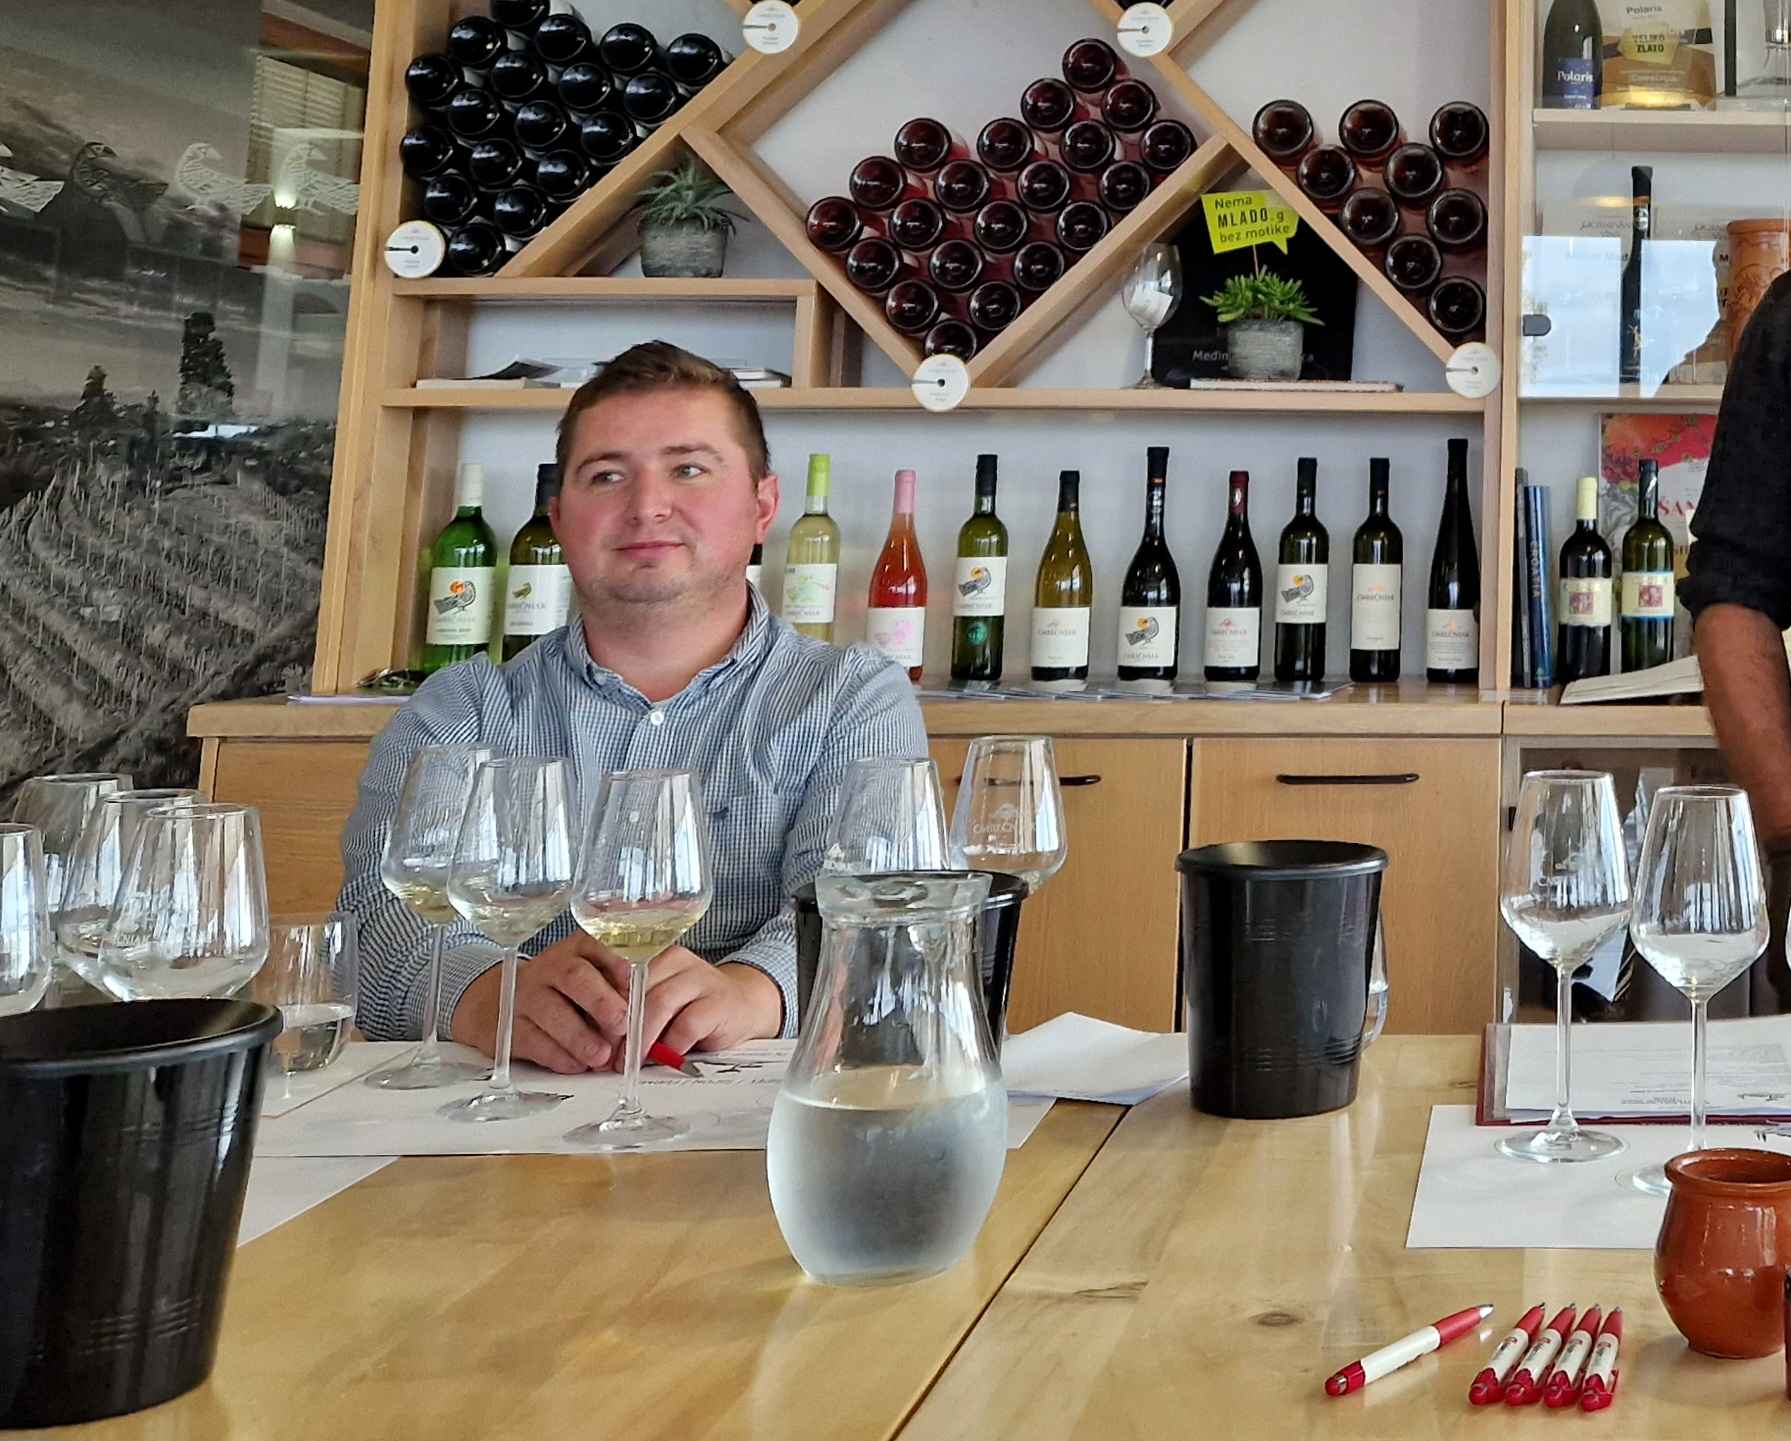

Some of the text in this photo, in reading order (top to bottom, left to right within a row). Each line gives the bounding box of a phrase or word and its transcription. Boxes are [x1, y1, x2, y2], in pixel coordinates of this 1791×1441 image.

[1214, 196, 1253, 210] Nema
[1219, 223, 1291, 243] bez motike
